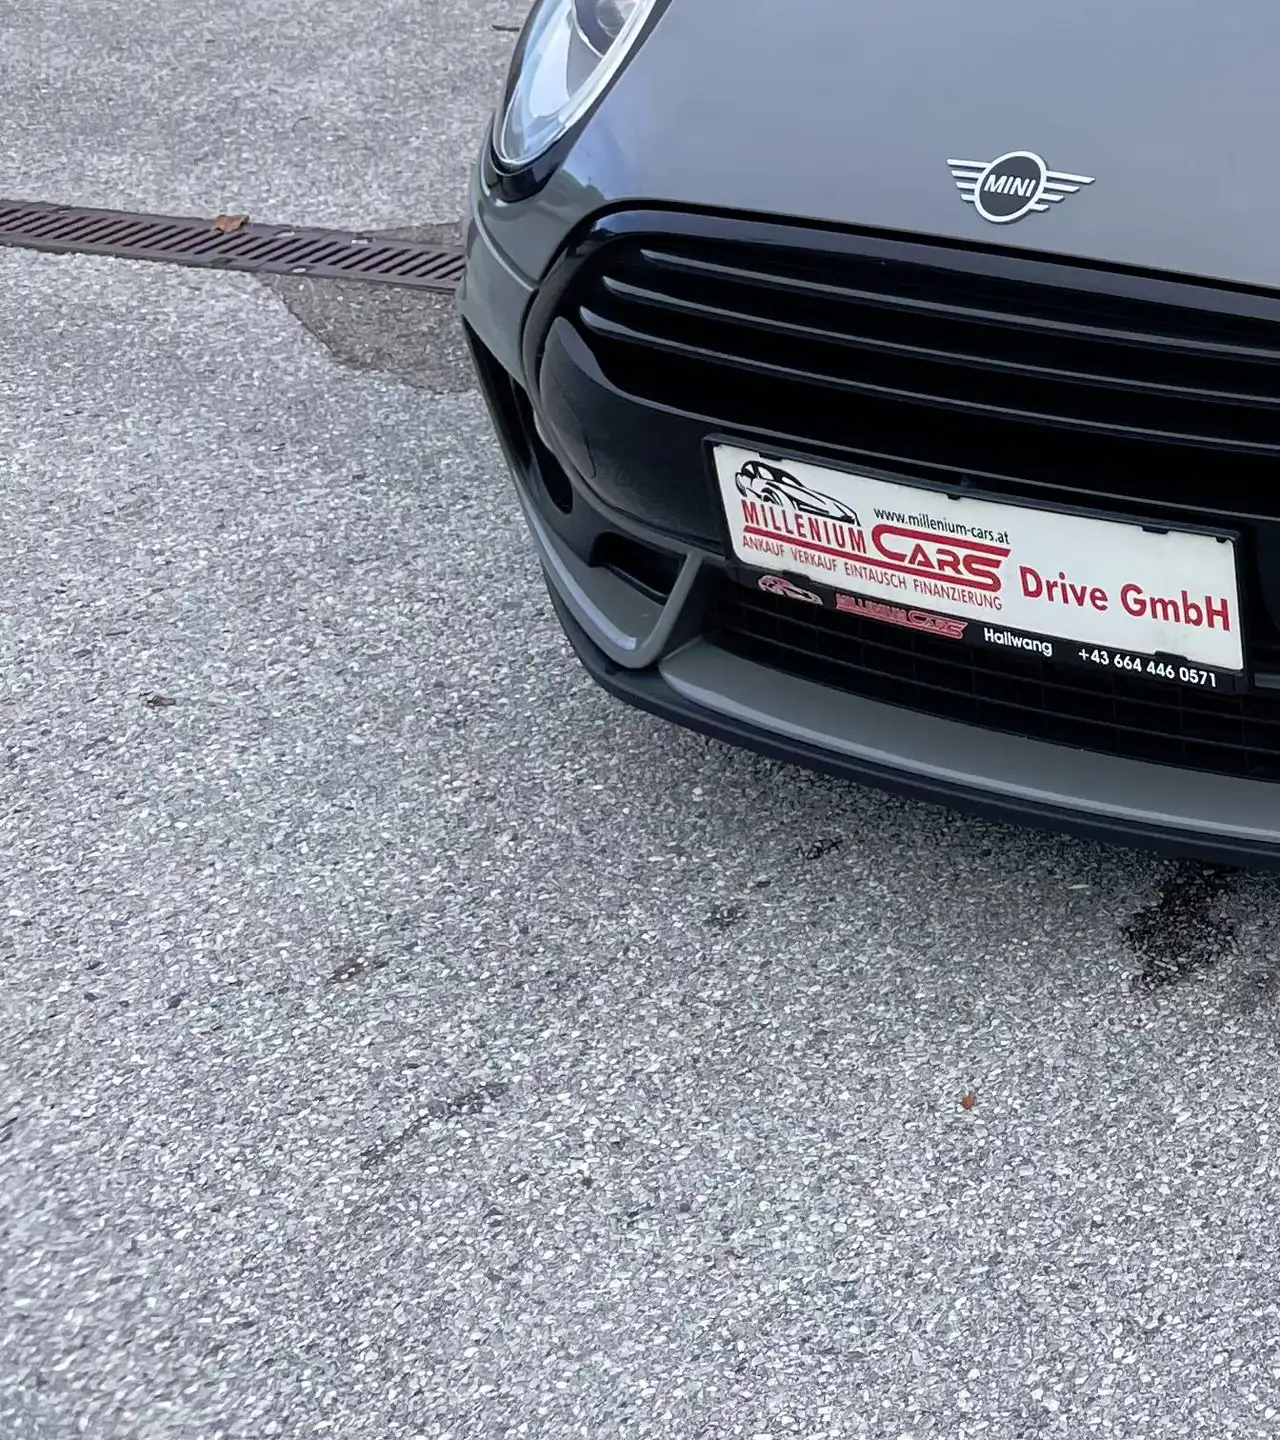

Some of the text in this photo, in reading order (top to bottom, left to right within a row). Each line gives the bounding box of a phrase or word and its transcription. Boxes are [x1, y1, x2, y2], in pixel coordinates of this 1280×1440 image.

[983, 173, 1037, 198] MINI
[741, 499, 1011, 593] MILLENIUM CARS
[873, 507, 1011, 545] www.millenium-cars.at
[742, 534, 1003, 611] ANKAUF VERKAUF EINTAUSCH FINANZIERUNG
[1019, 565, 1232, 632] Drive GmbH
[983, 627, 1217, 688] Hallwang +43 664 446 0571
